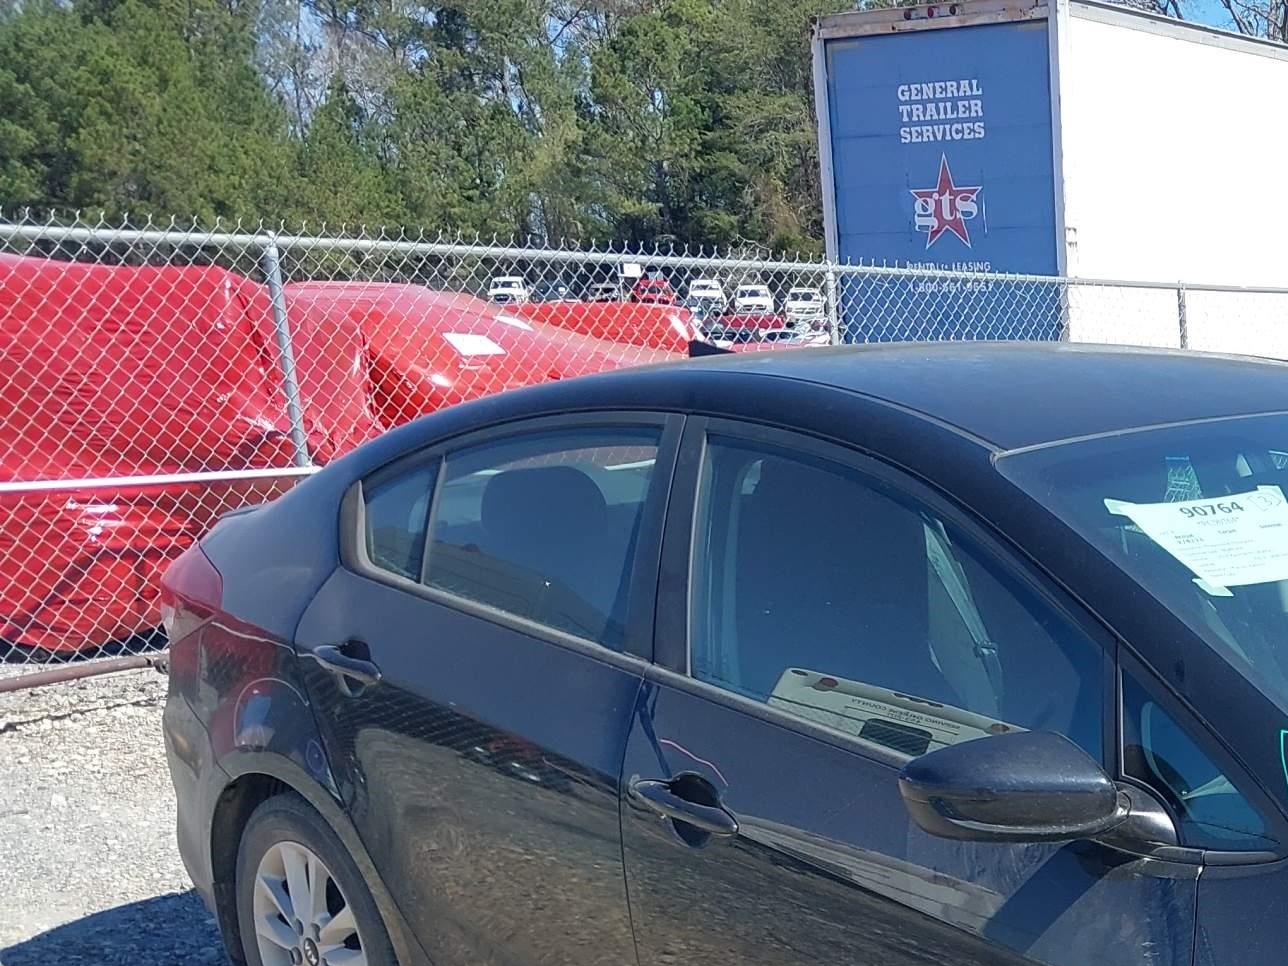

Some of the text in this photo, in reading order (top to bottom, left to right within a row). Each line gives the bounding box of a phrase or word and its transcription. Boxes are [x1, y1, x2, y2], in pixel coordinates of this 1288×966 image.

[897, 79, 983, 102] GENERAL
[899, 99, 984, 122] TRAILER
[900, 121, 985, 144] SERVICES
[914, 188, 979, 232] gts
[1179, 500, 1245, 519] 90764
